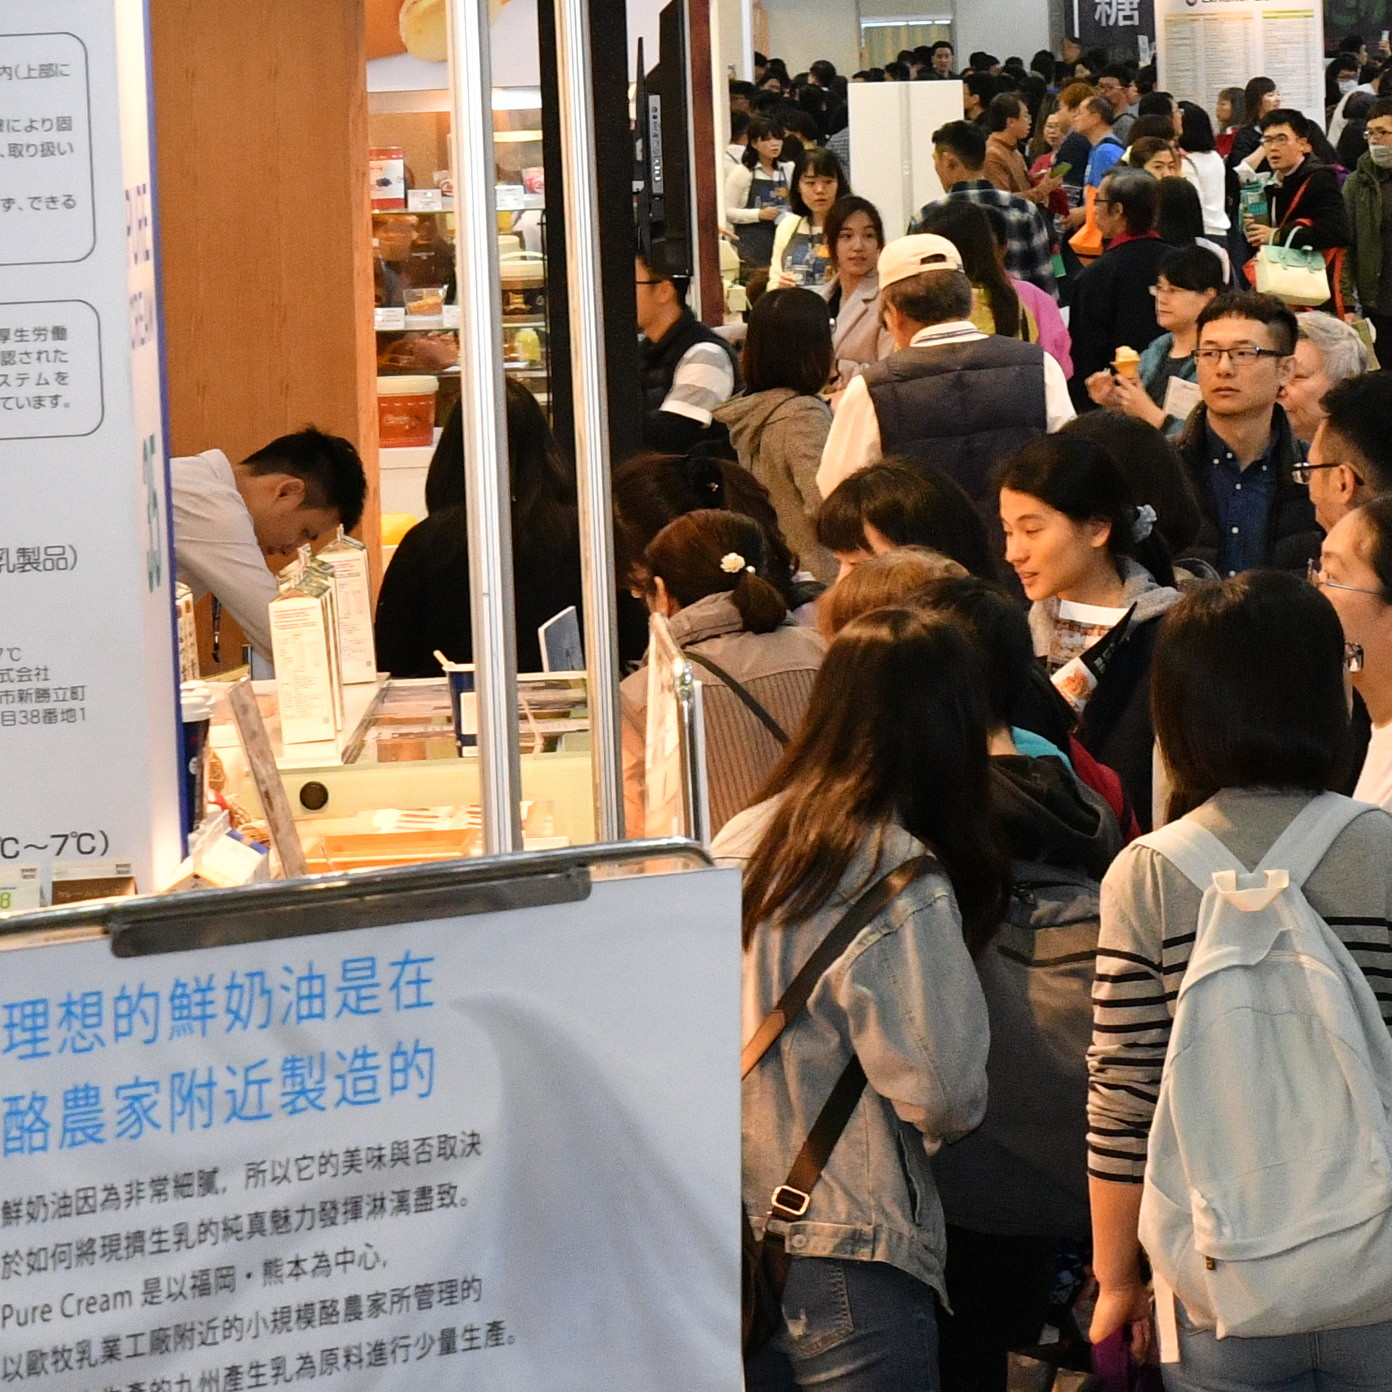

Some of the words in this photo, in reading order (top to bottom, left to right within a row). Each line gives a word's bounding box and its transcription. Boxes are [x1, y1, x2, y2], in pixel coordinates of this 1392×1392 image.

[0, 116, 73, 133] により固
[1, 949, 436, 1063] 理想的鮮奶油是在
[1, 1039, 436, 1157] 酪農家附近製造的
[1, 1303, 53, 1329] Pure
[60, 1289, 133, 1318] Cream
